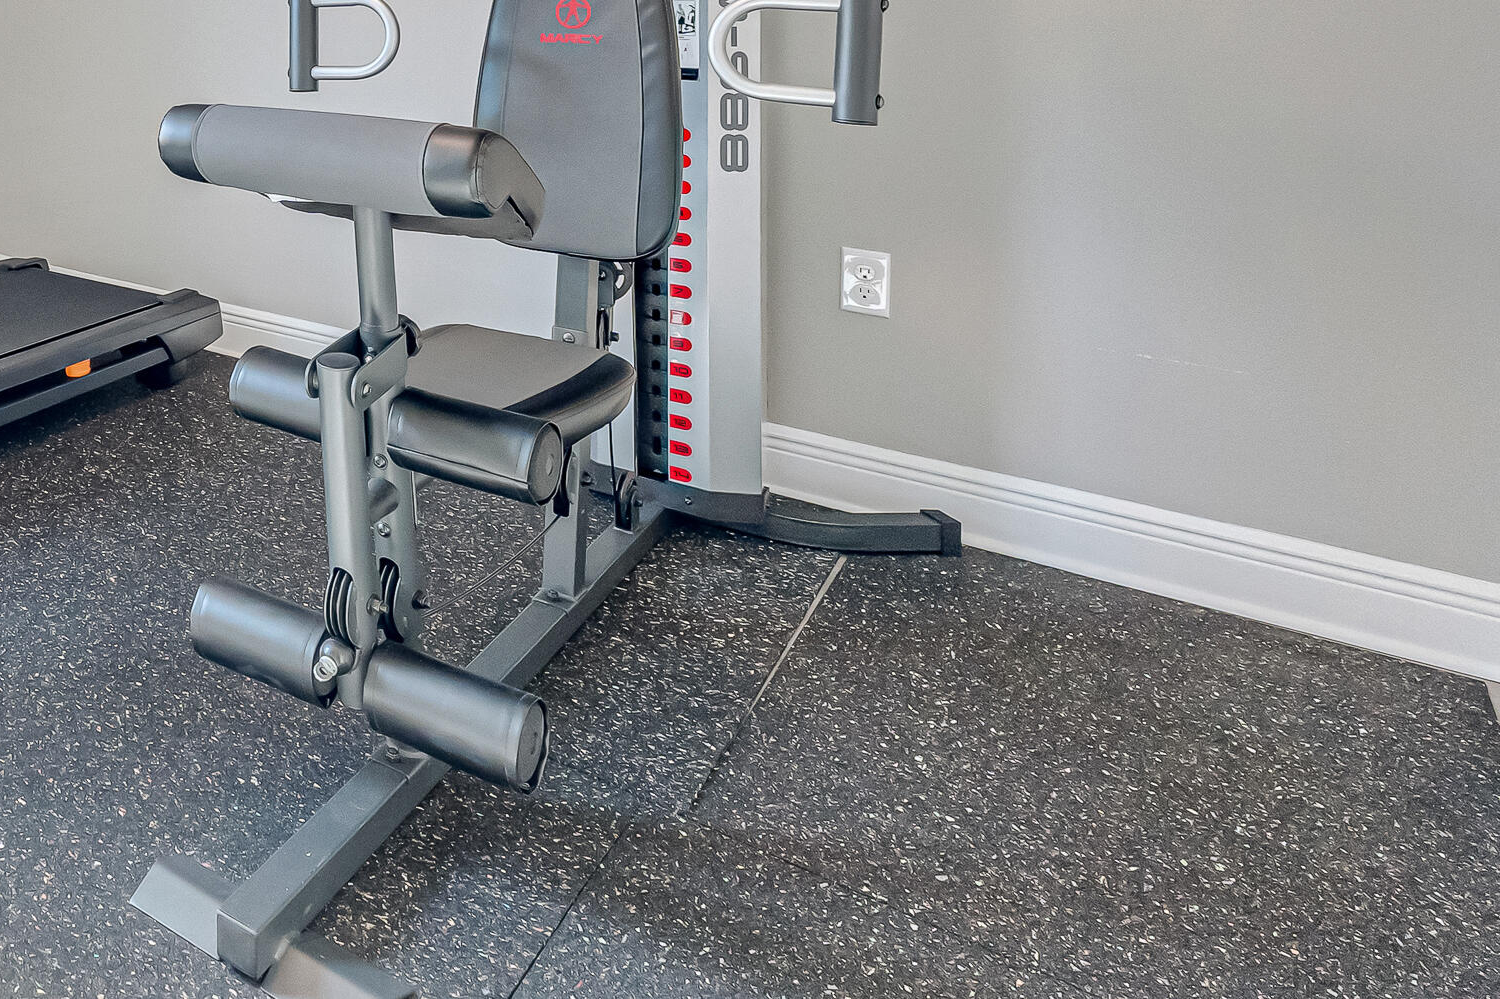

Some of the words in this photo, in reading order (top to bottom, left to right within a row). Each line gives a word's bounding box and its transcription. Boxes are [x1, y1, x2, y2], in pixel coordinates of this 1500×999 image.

[673, 366, 688, 375] 10
[673, 392, 683, 400] 11
[673, 470, 689, 479] 14
